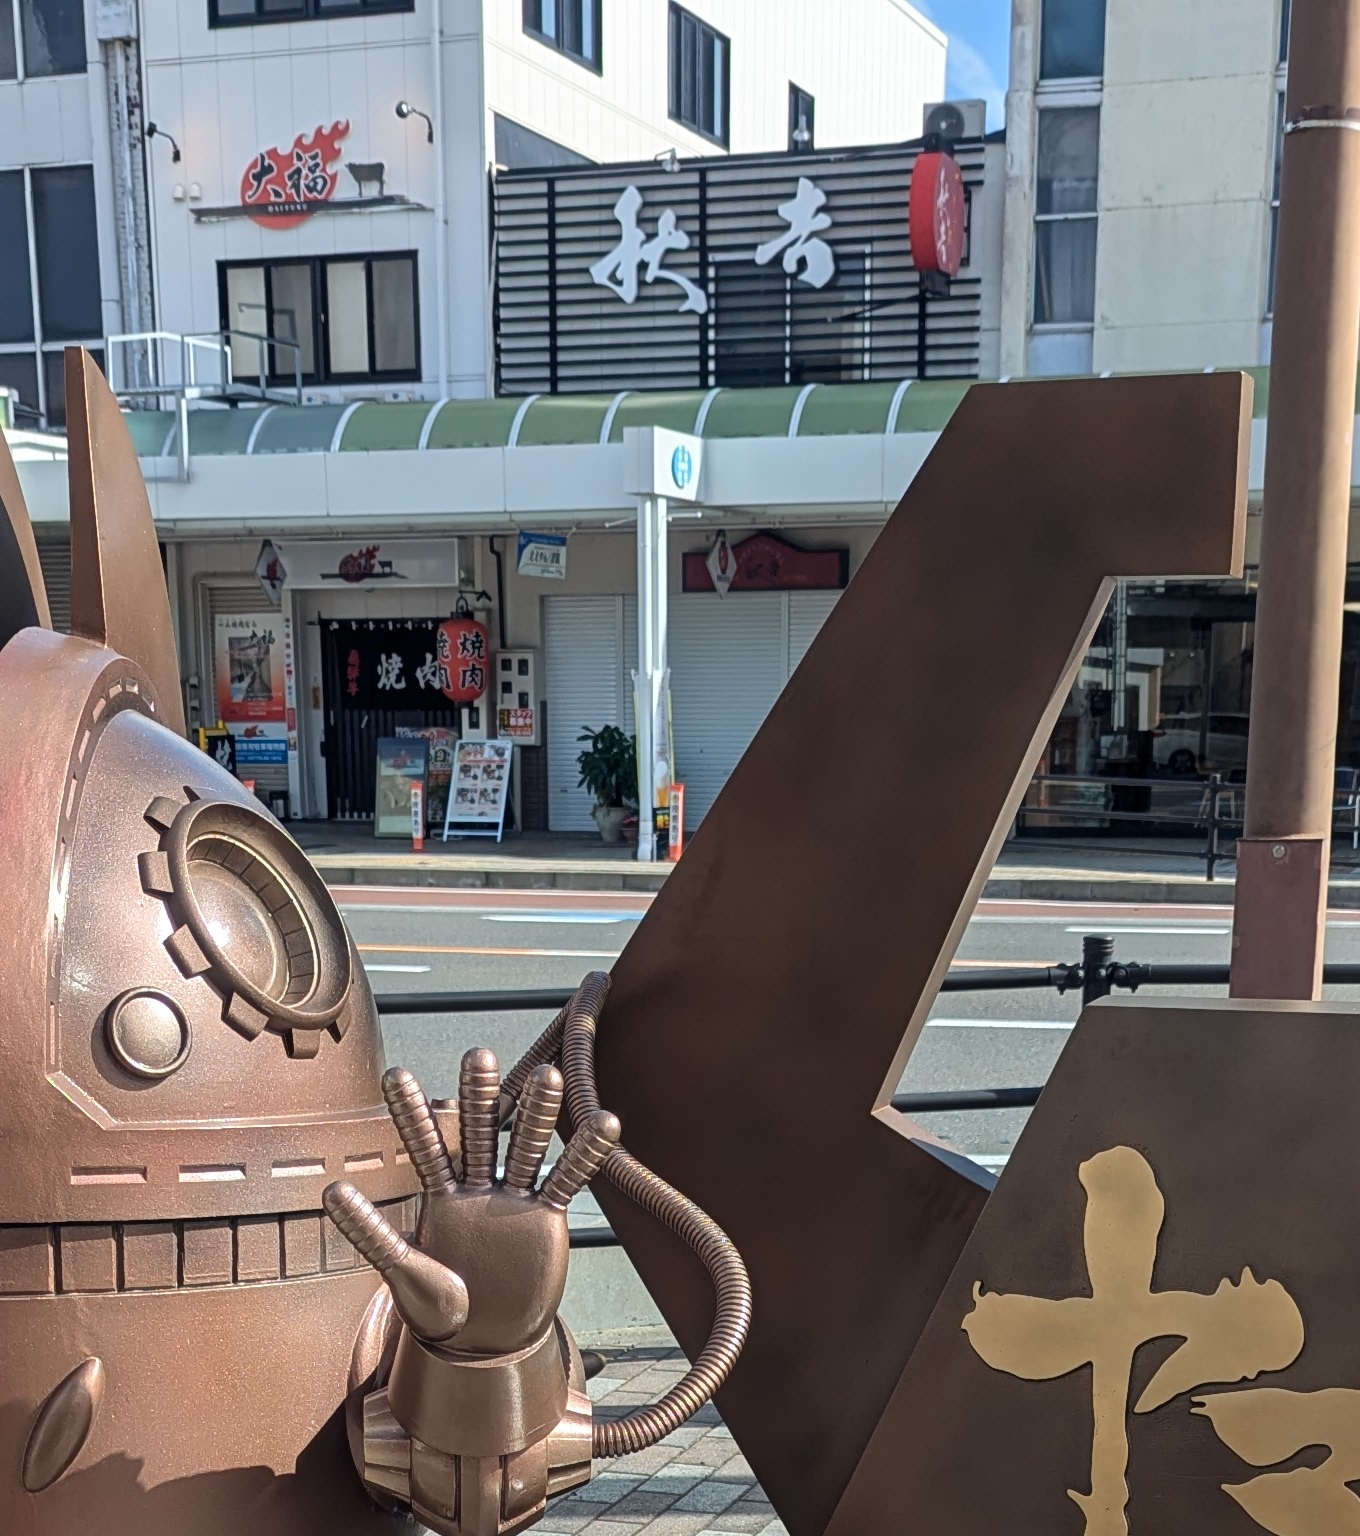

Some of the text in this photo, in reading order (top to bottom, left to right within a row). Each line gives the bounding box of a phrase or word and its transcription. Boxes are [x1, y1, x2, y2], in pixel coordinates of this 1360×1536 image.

[246, 151, 328, 201] 大福
[590, 177, 835, 314] 秋吉
[376, 652, 440, 691] 焼肉
[458, 630, 486, 691] 焼肉
